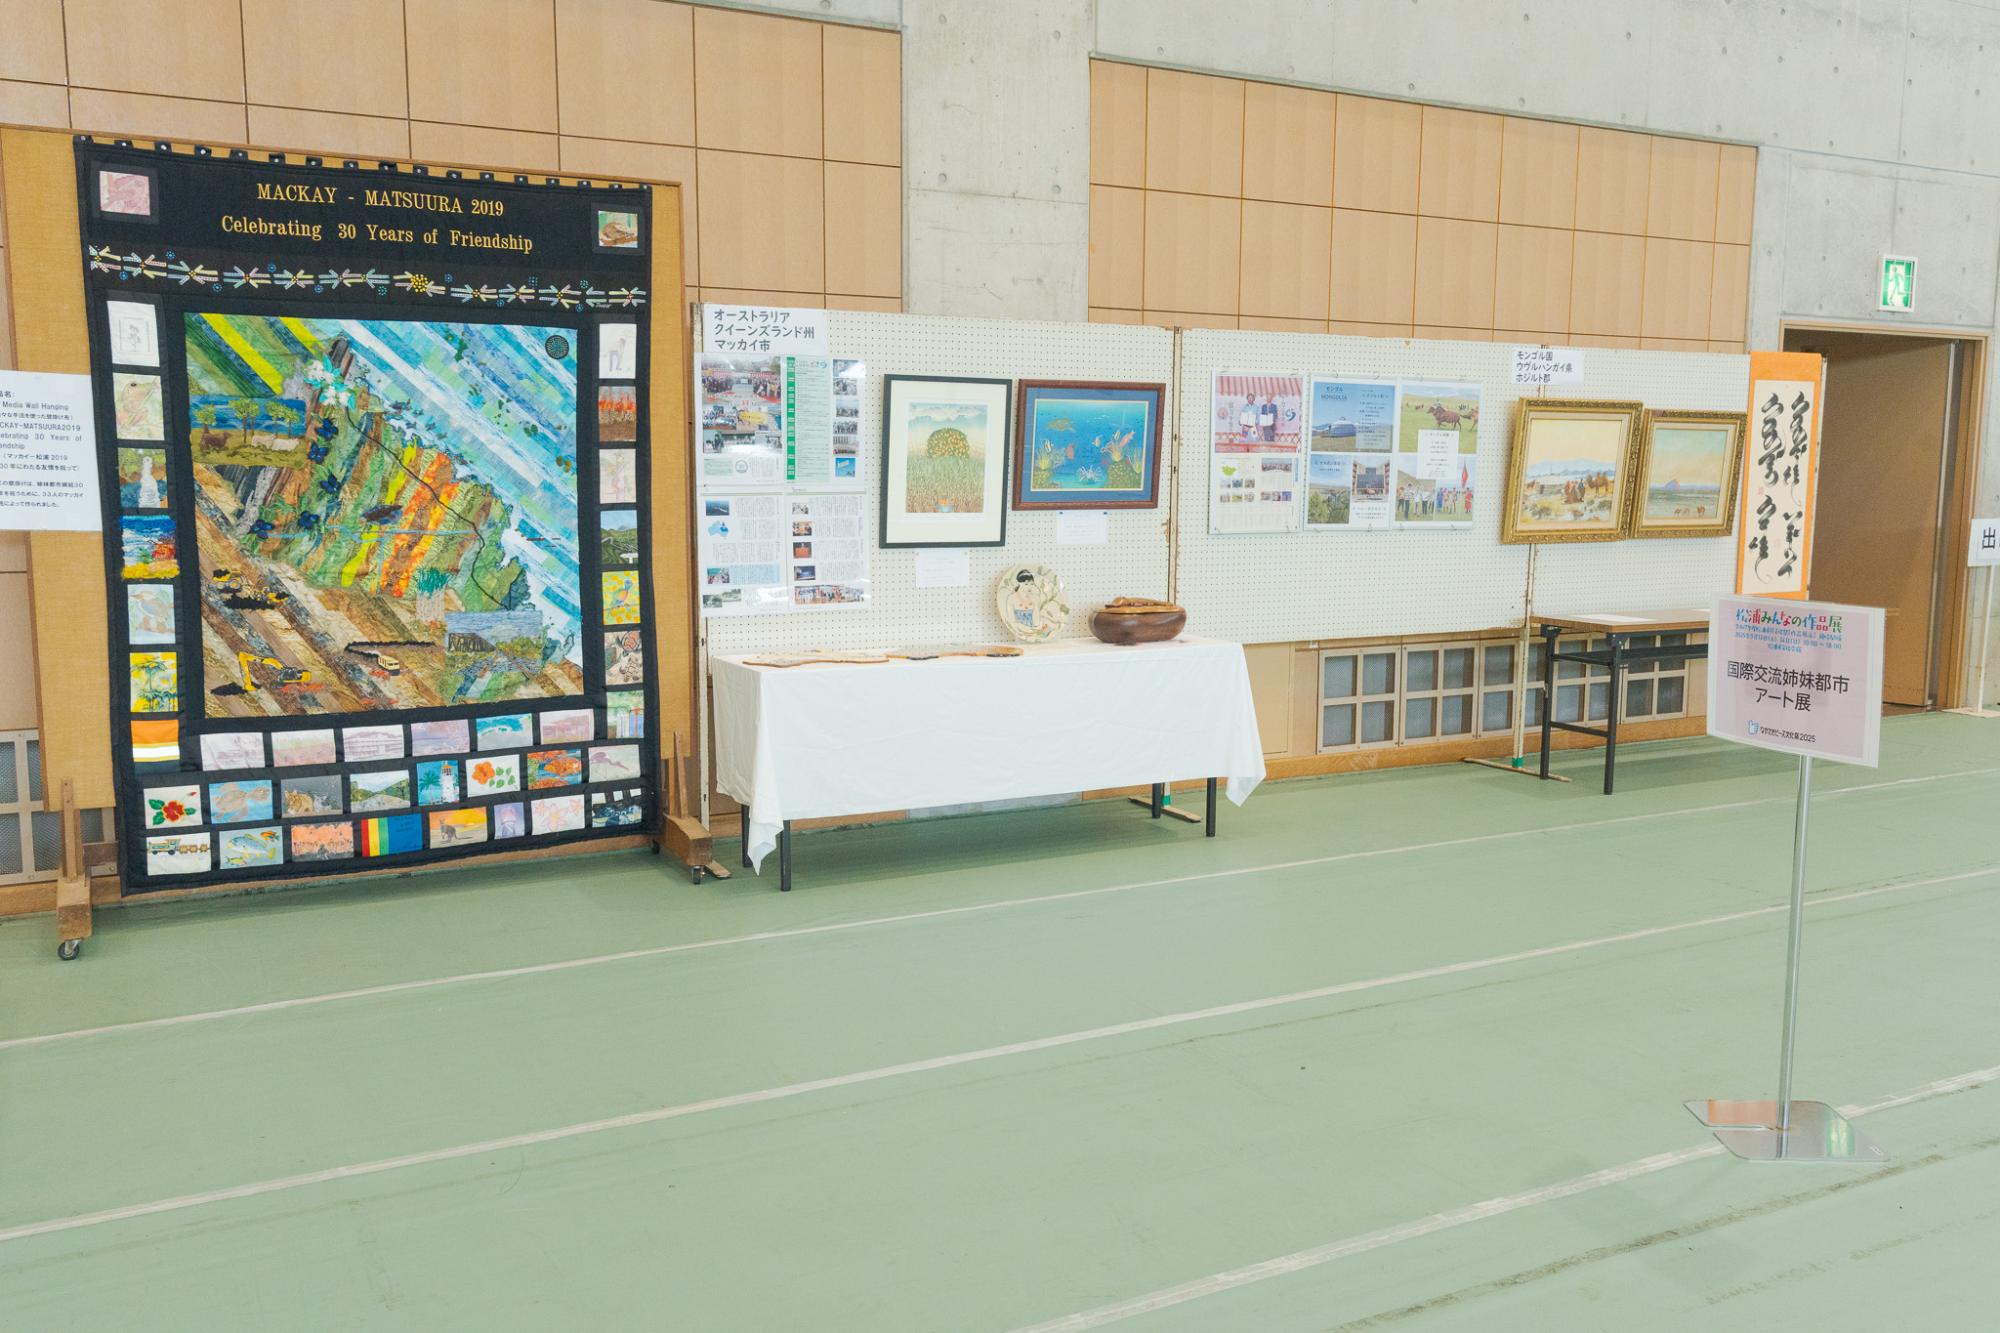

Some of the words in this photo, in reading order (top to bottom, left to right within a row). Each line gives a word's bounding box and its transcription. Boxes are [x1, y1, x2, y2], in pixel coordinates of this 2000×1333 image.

[257, 183, 337, 204] MACKAY
[364, 189, 463, 214] MATSUURA
[471, 199, 504, 217] 2019
[221, 215, 322, 241] Celebrating
[338, 223, 356, 239] 30
[366, 224, 414, 244] Years
[423, 229, 439, 245] of
[449, 230, 533, 254] Friendship
[714, 309, 790, 323] オーストラリア
[714, 323, 815, 339] クイーンズランド州
[714, 338, 771, 352] マッカイ市
[1517, 351, 1553, 361] モンゴル国
[1515, 373, 1551, 383] ホジルト郡
[2, 401, 23, 409] Media
[41, 403, 69, 411] Hanging
[1982, 527, 2000, 549] 出
[1735, 608, 1842, 633] 松浦みんなの作品展
[1727, 660, 1850, 694] 国際交流姉妹都市
[1755, 687, 1811, 712] アート展
